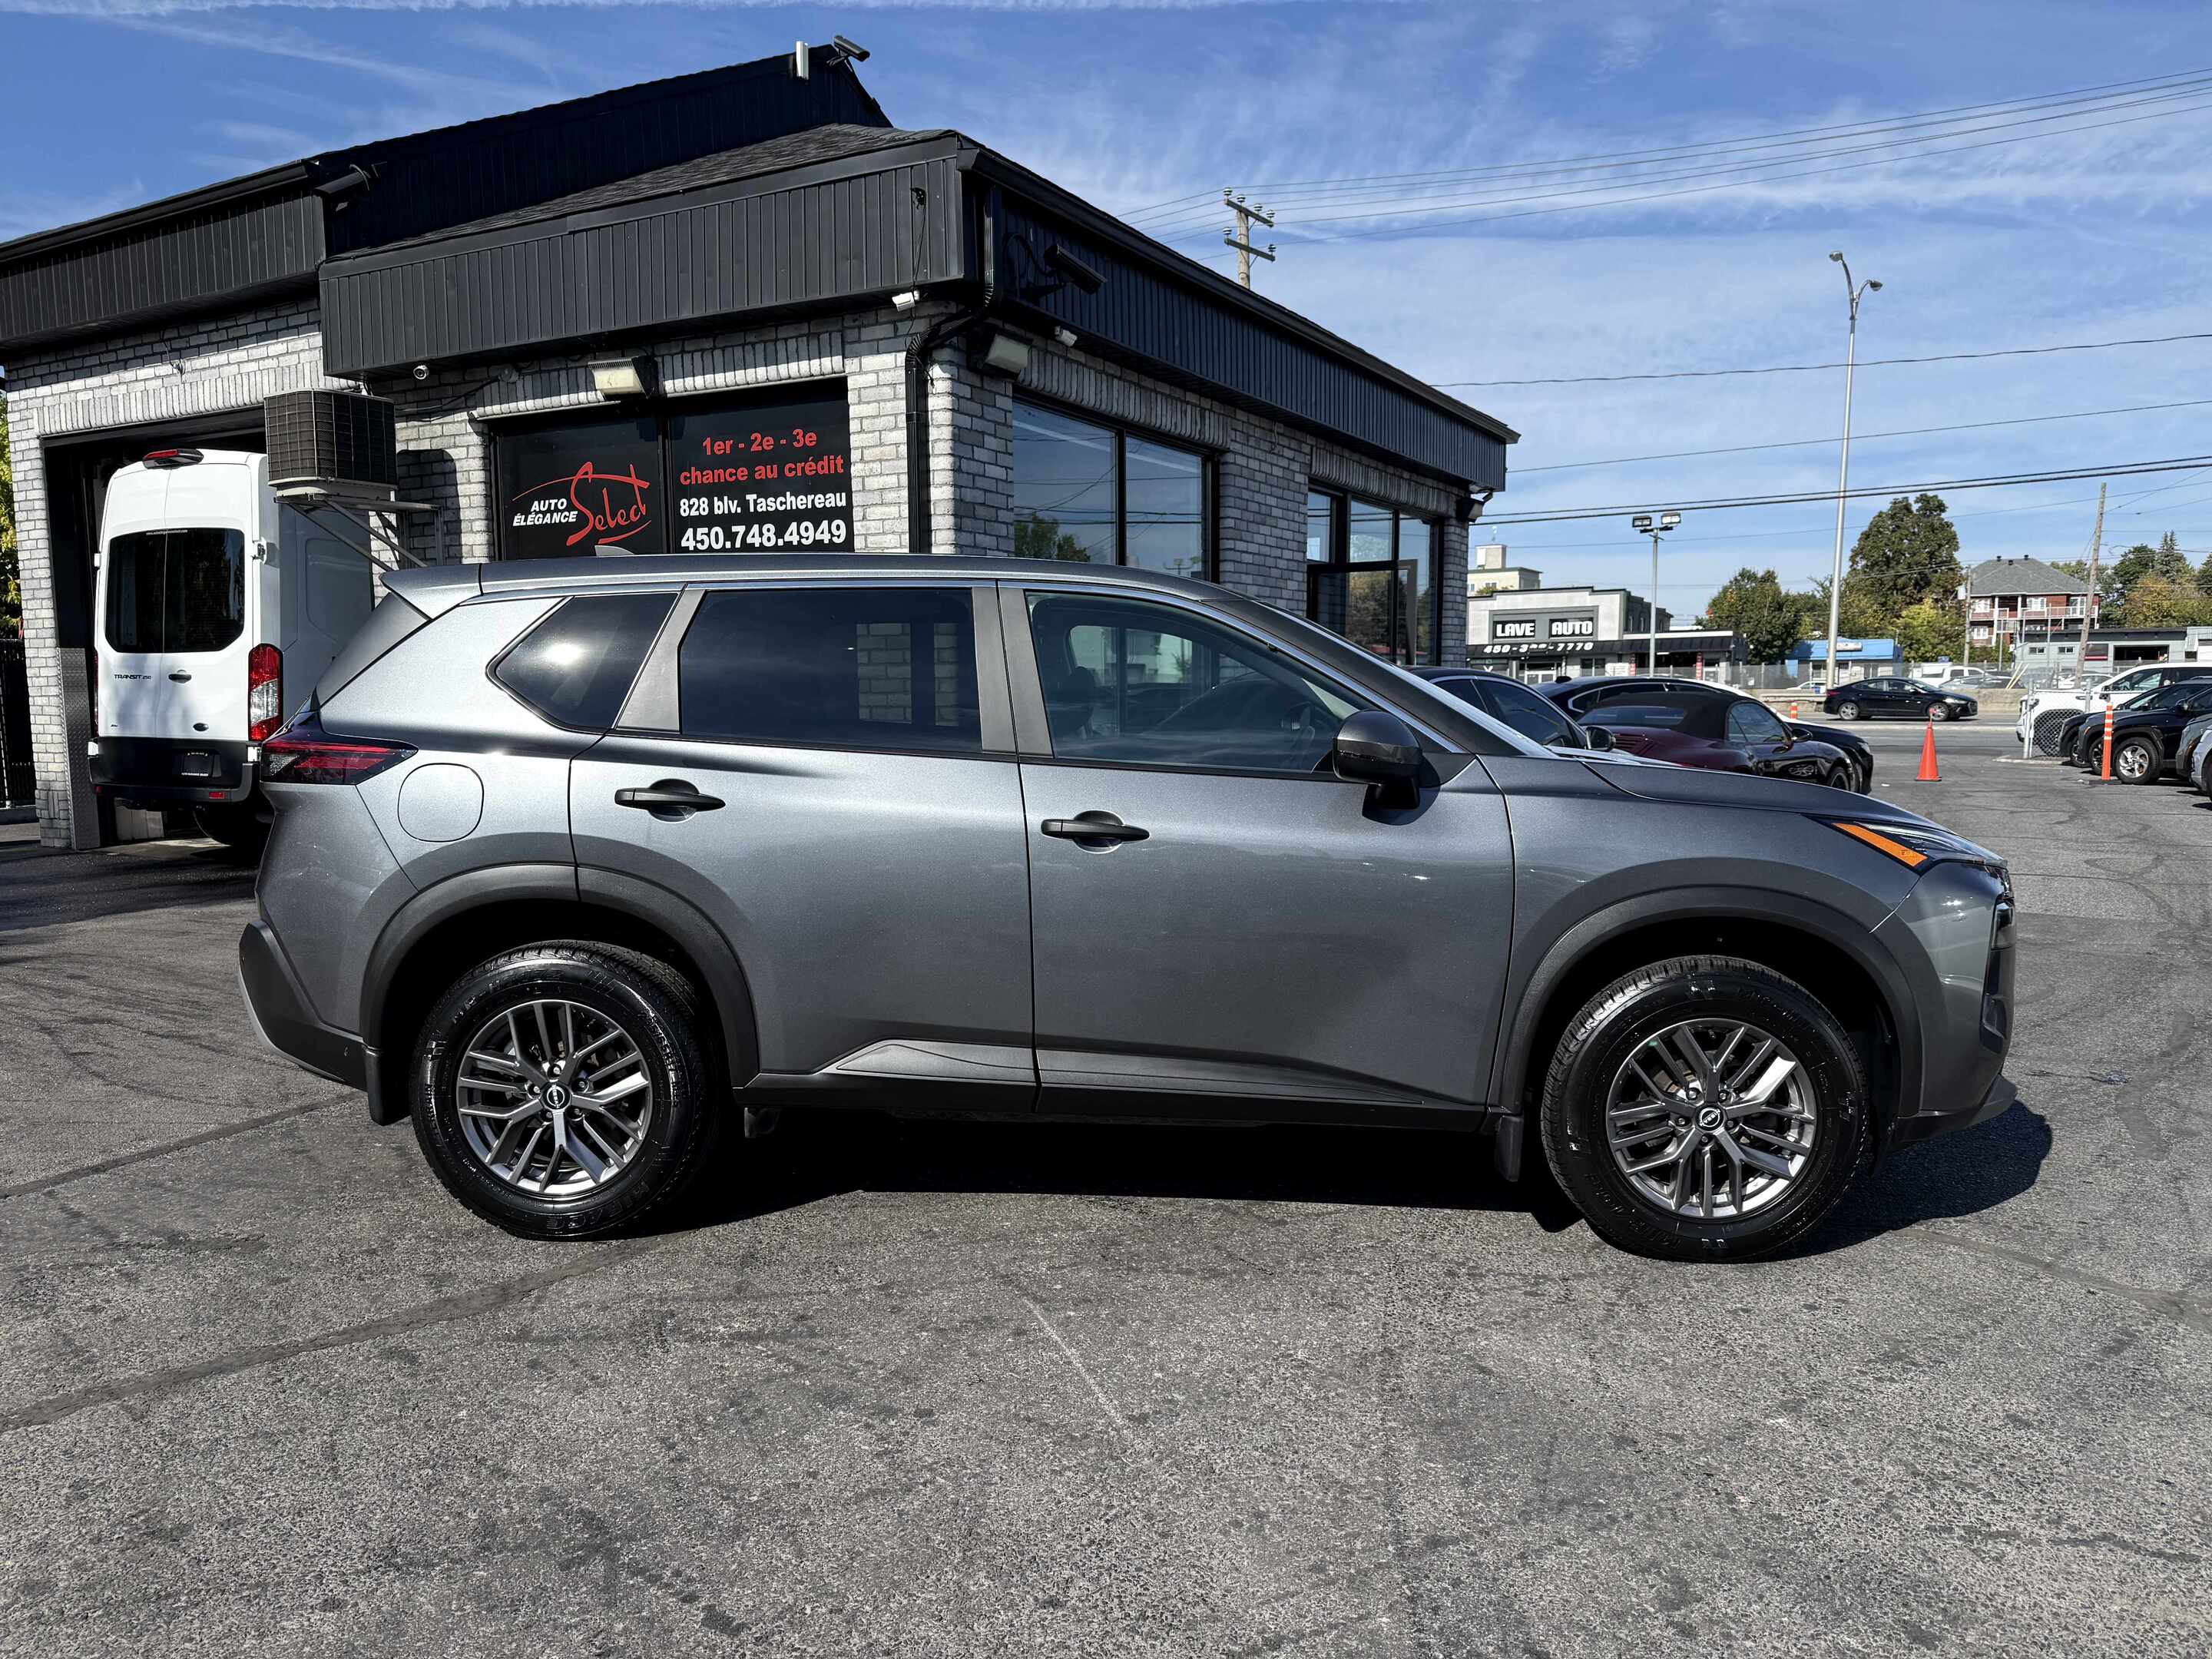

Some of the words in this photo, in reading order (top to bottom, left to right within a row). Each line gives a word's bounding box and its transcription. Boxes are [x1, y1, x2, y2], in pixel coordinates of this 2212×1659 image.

[702, 437, 733, 455] 1er
[750, 432, 774, 452] 2e
[793, 429, 817, 448] 3e
[680, 466, 748, 485] chance
[754, 464, 778, 480] au
[784, 455, 844, 477] crédit
[531, 498, 568, 512] AUTO
[566, 462, 651, 546] Select
[680, 497, 709, 517] 828
[714, 495, 741, 515] blv.
[746, 492, 846, 512] Taschereau
[512, 511, 578, 527] ÉLÉGANCE
[680, 519, 846, 551] 450.748.4949
[1496, 623, 1535, 637] LAVE
[1551, 621, 1593, 635] AUTO
